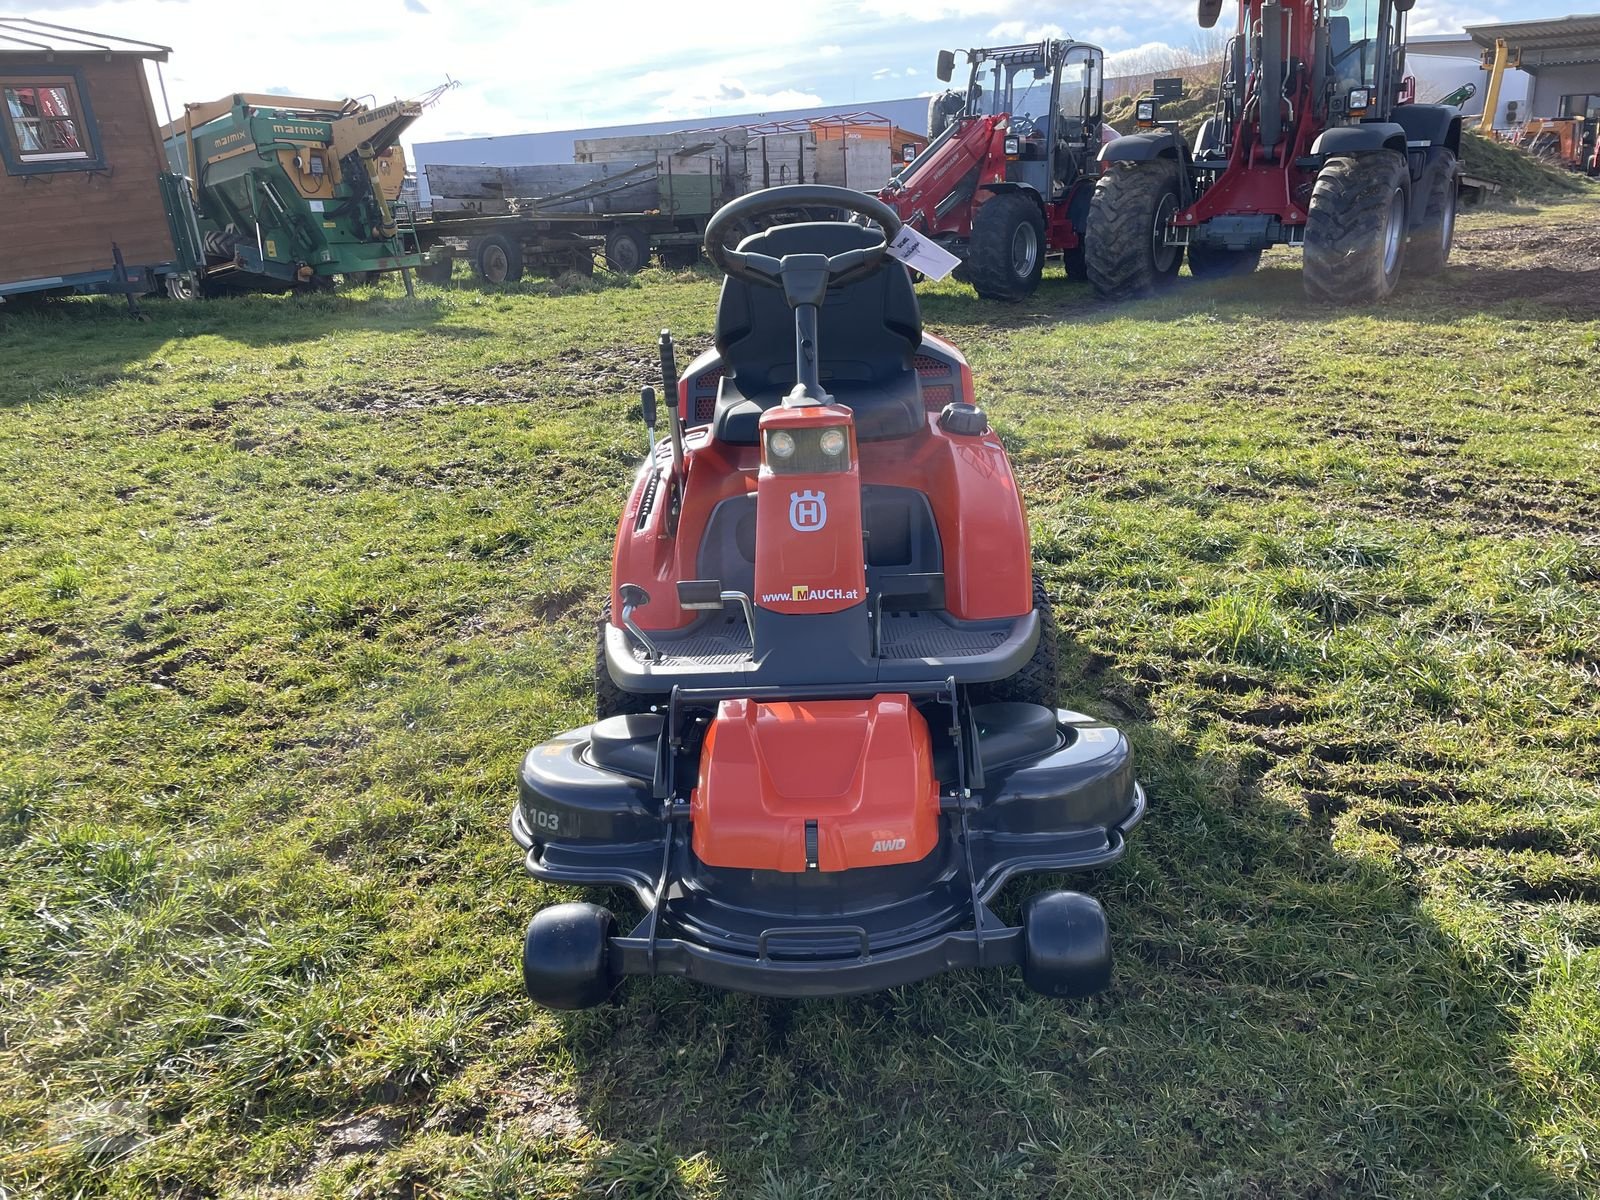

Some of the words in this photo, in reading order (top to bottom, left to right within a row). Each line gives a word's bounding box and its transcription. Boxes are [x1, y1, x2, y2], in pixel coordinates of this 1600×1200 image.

[357, 104, 398, 125] marmix
[273, 124, 324, 136] marmix
[214, 130, 246, 148] marmix
[762, 588, 858, 602] www.MAUCH.at
[530, 809, 559, 830] 103
[872, 838, 906, 852] AWD
